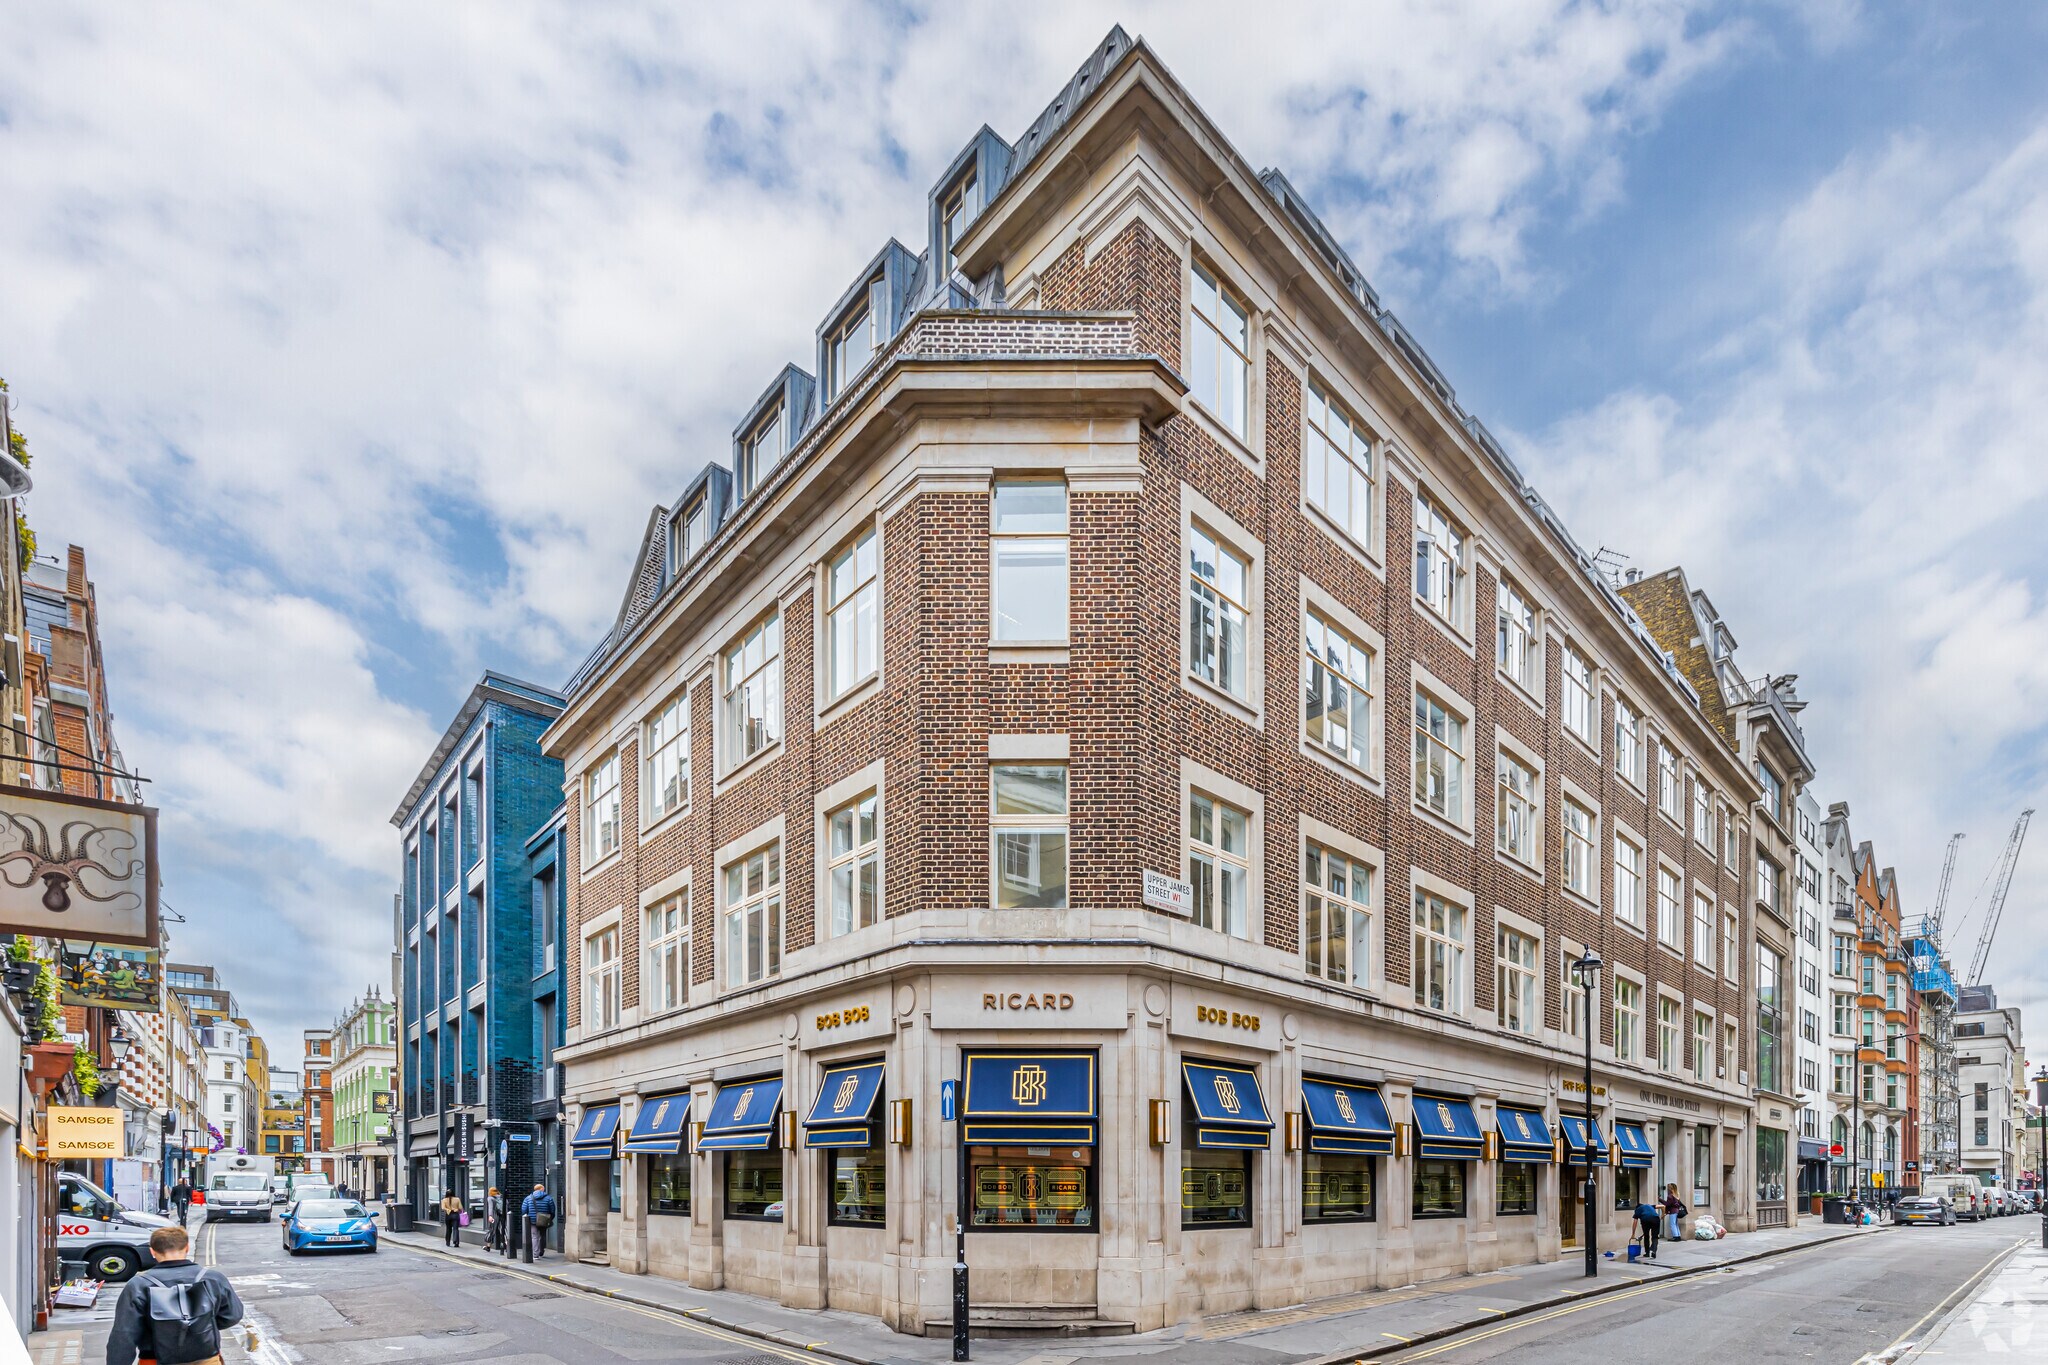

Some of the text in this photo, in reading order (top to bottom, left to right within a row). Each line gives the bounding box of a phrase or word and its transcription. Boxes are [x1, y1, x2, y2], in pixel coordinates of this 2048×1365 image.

[1147, 873, 1190, 896] UPPER JAMES
[1147, 884, 1181, 903] STREET W1
[983, 993, 1074, 1010] RICARD
[816, 1005, 869, 1031] BOB BOB
[1197, 1005, 1260, 1032] BOB BOB
[1640, 1089, 1701, 1113] ONE UPPER JAMES STREET
[57, 1115, 115, 1125] SAMSØE
[58, 1141, 115, 1150] SAMSØE
